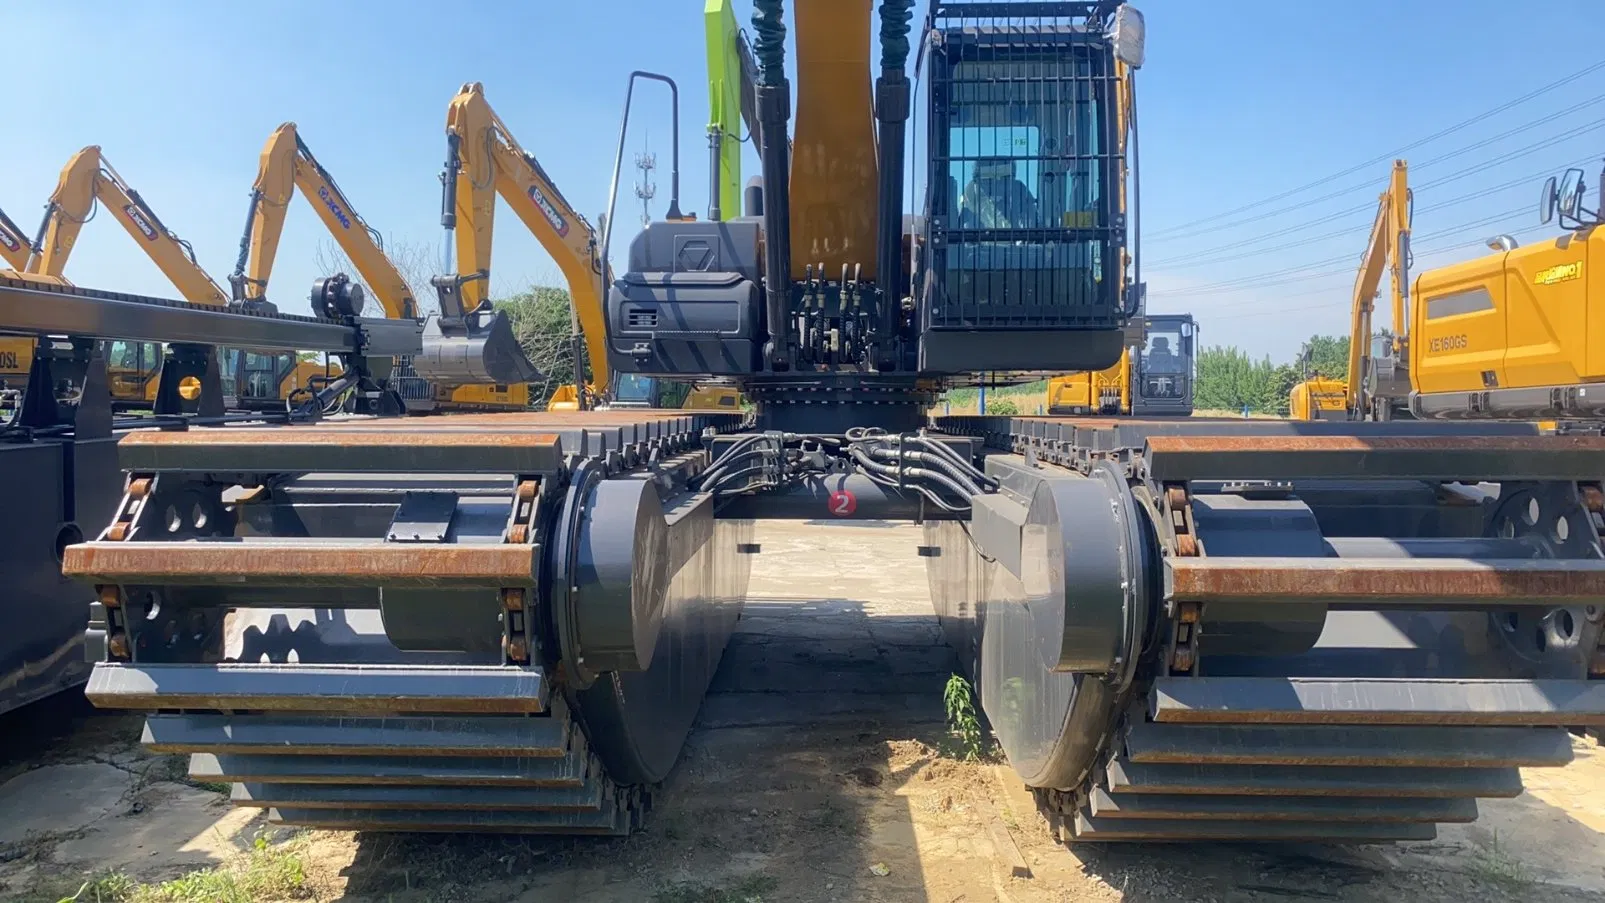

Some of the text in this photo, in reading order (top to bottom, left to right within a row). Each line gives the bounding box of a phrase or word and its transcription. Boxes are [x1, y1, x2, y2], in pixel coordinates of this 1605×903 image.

[132, 213, 152, 236] XCMG
[540, 198, 562, 230] XCMG
[1428, 334, 1467, 353] XE160GS
[834, 495, 849, 513] 2
